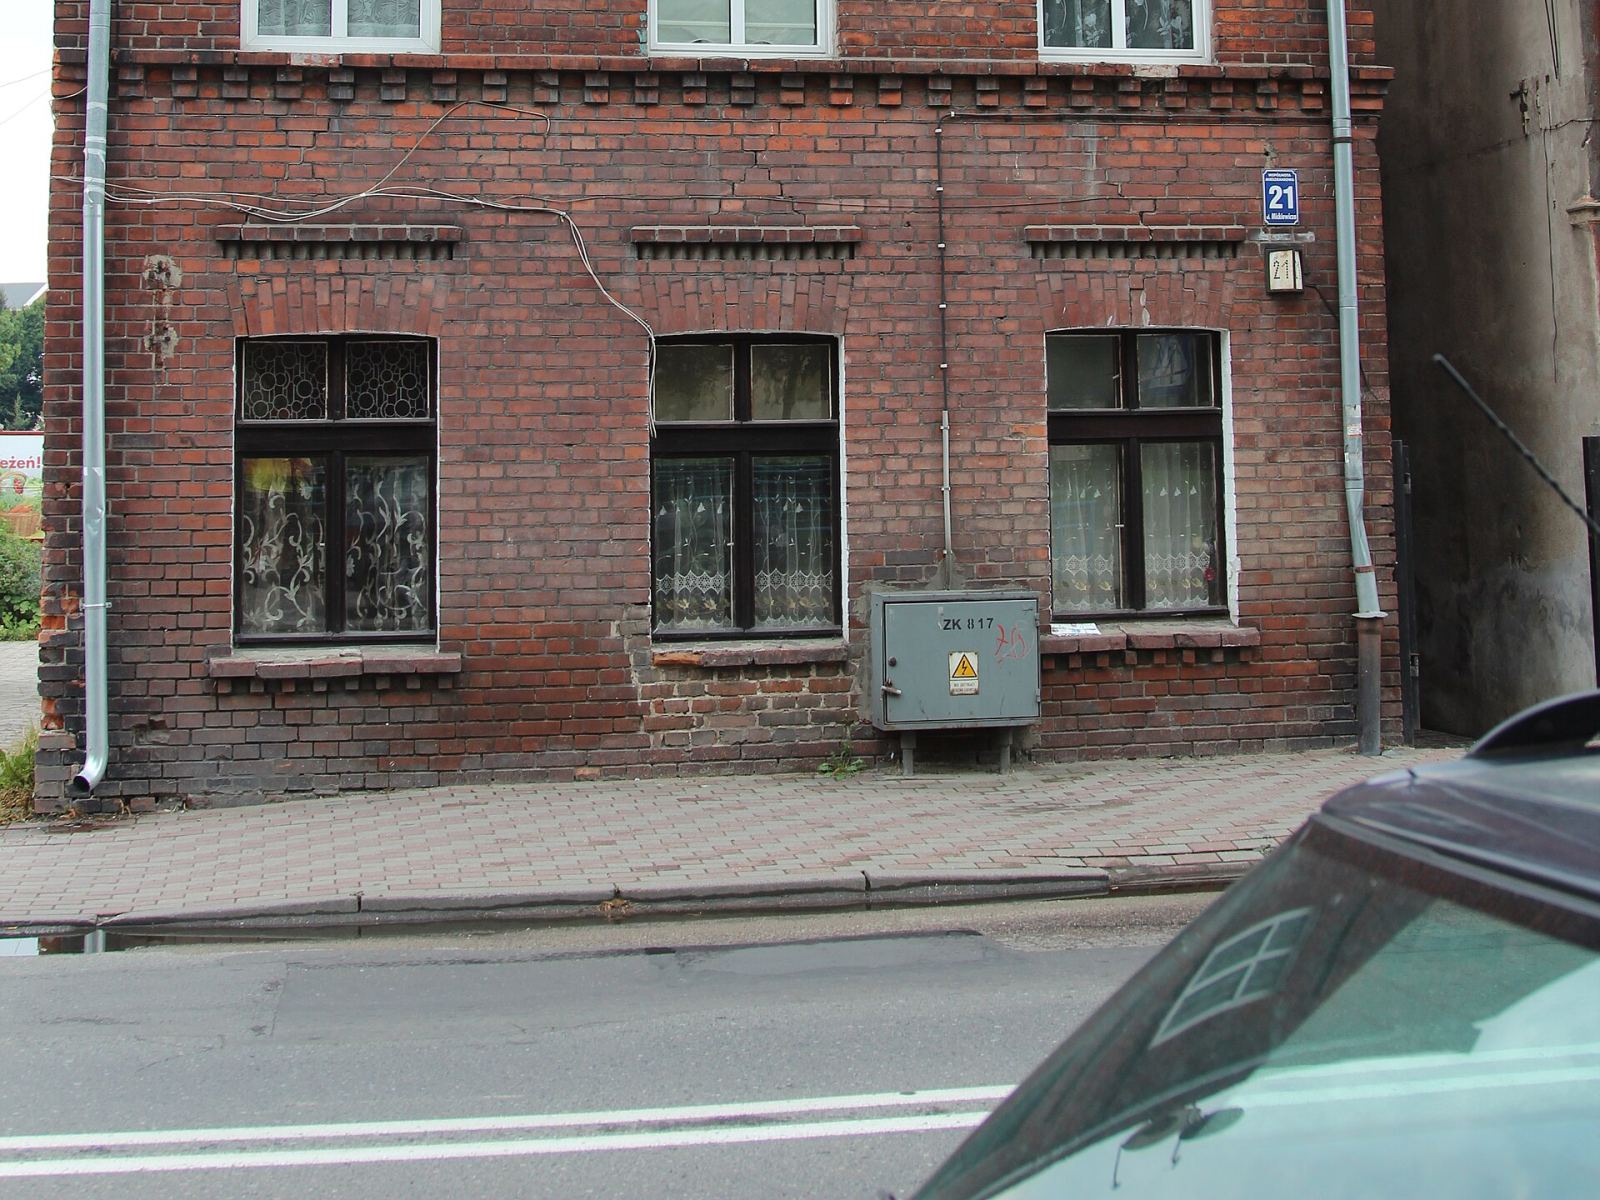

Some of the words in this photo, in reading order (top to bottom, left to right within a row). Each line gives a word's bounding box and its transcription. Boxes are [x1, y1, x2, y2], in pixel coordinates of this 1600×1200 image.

[1268, 185, 1294, 209] 21
[943, 619, 962, 631] ZK
[967, 617, 994, 629] 817
